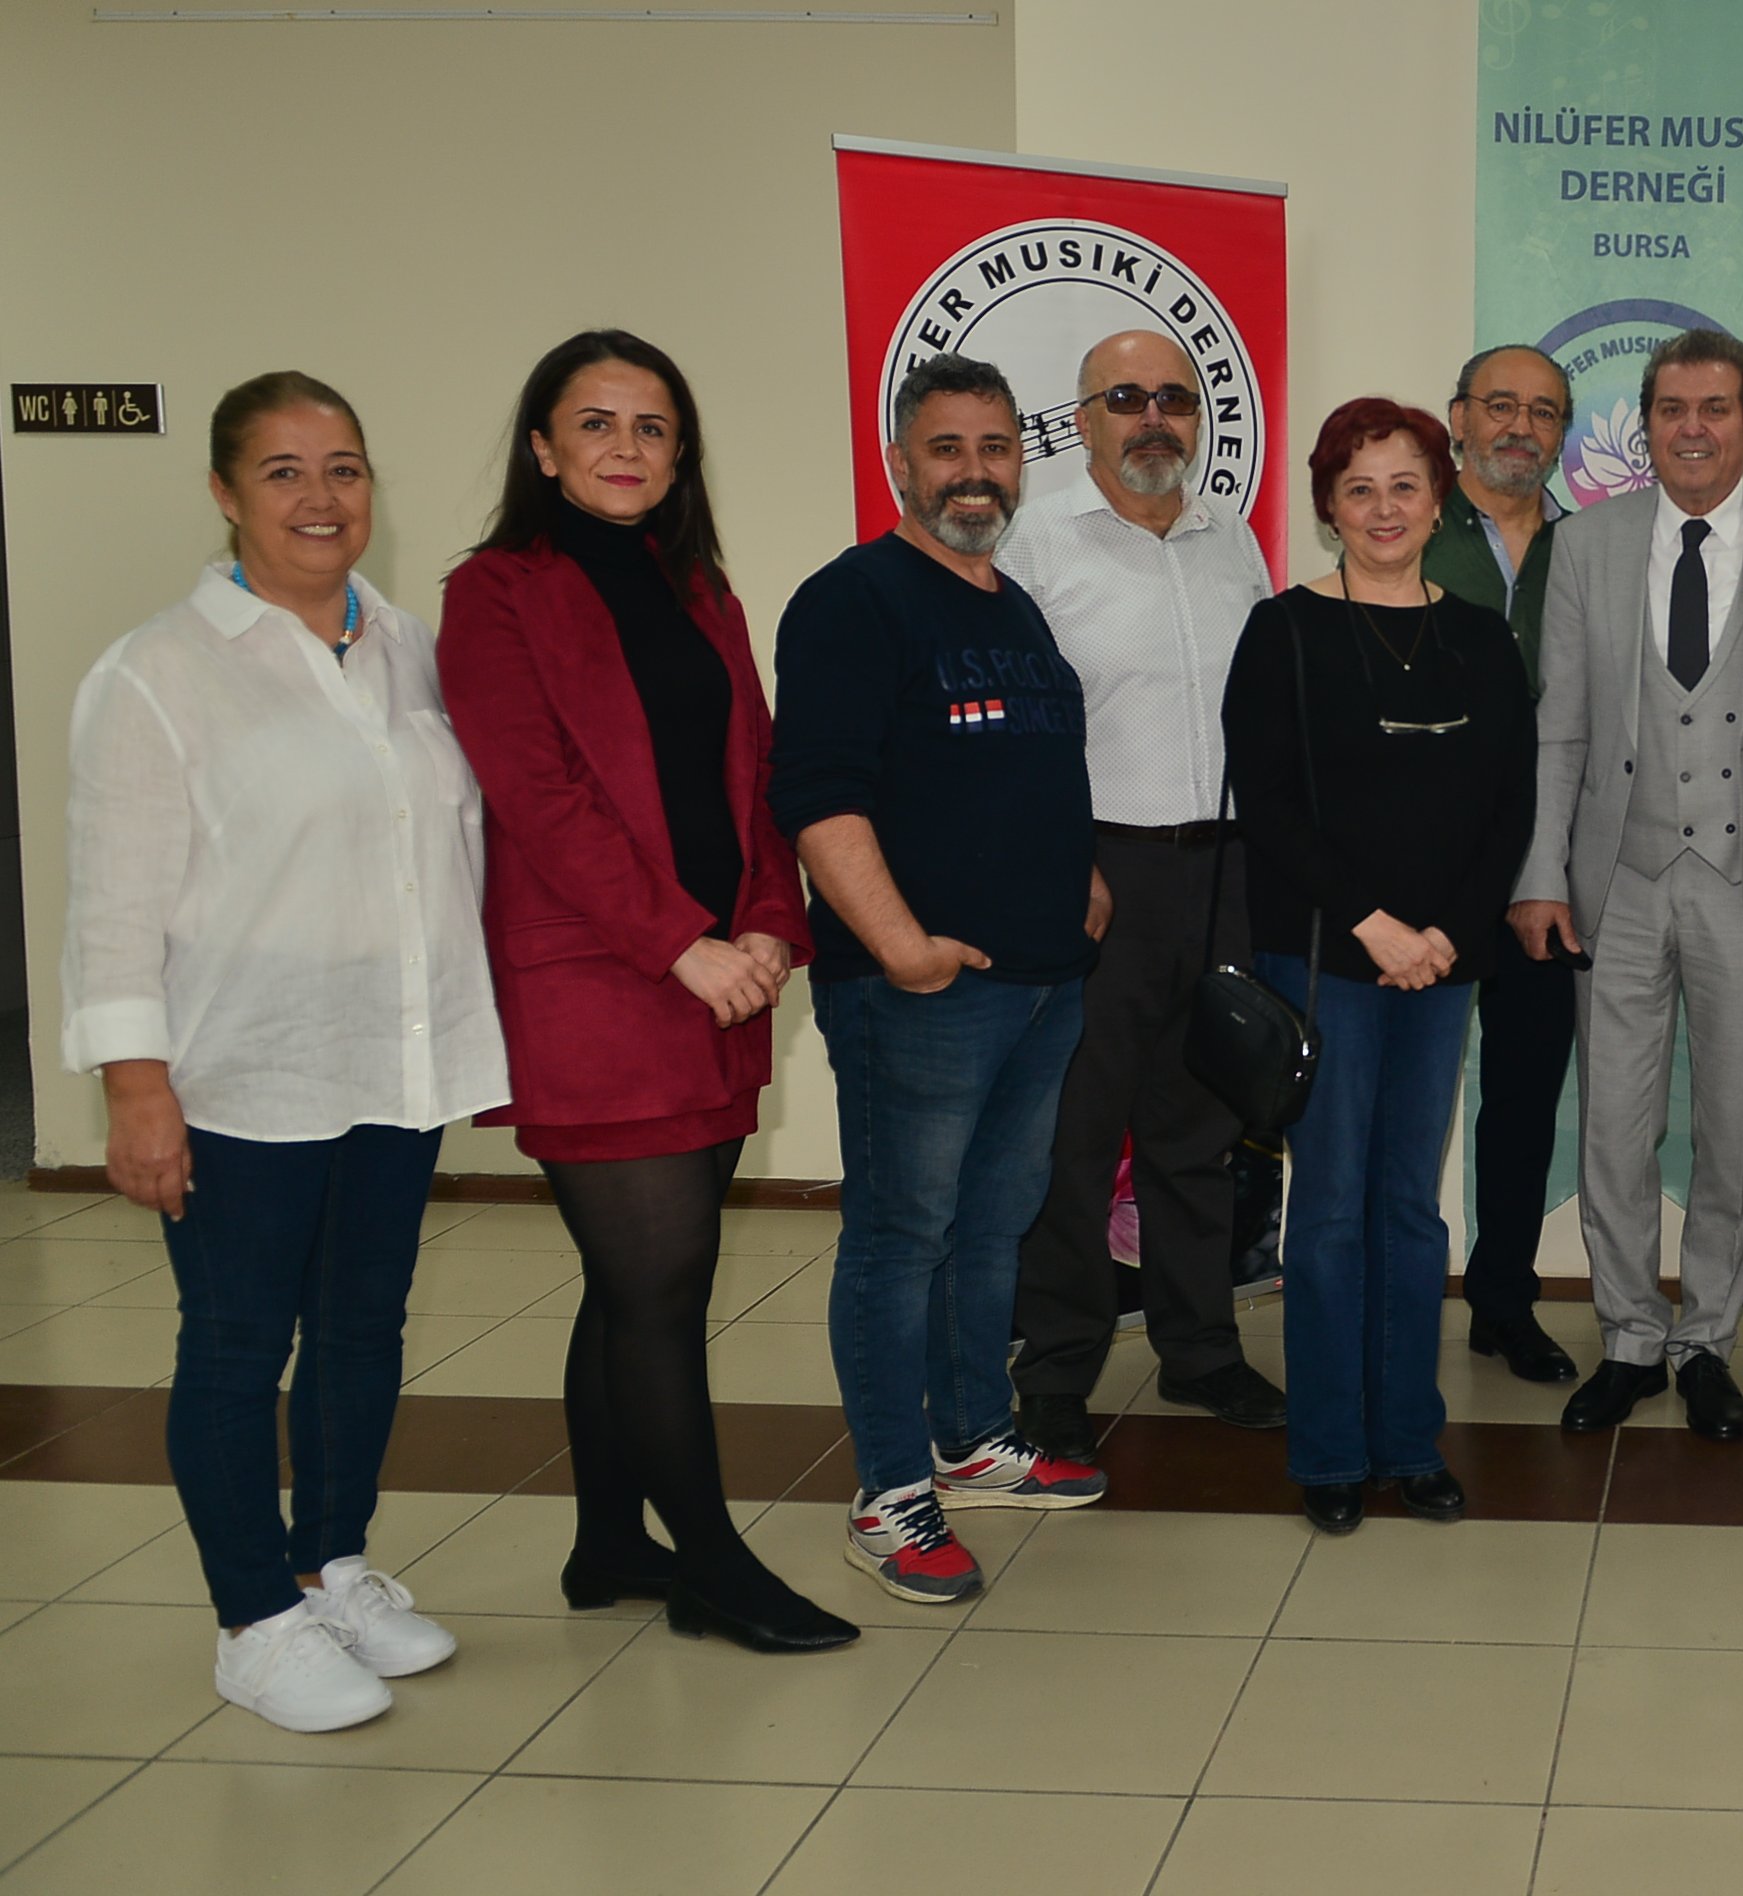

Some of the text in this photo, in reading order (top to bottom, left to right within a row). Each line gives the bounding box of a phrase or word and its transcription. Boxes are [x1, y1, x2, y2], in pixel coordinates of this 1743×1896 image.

[1494, 106, 1650, 147] NİLÜFER
[1560, 165, 1726, 203] DERNEĞİ
[1593, 233, 1690, 258] BURSA
[977, 239, 1243, 496] MUSIKİ DERNEĞ
[18, 395, 50, 422] WC
